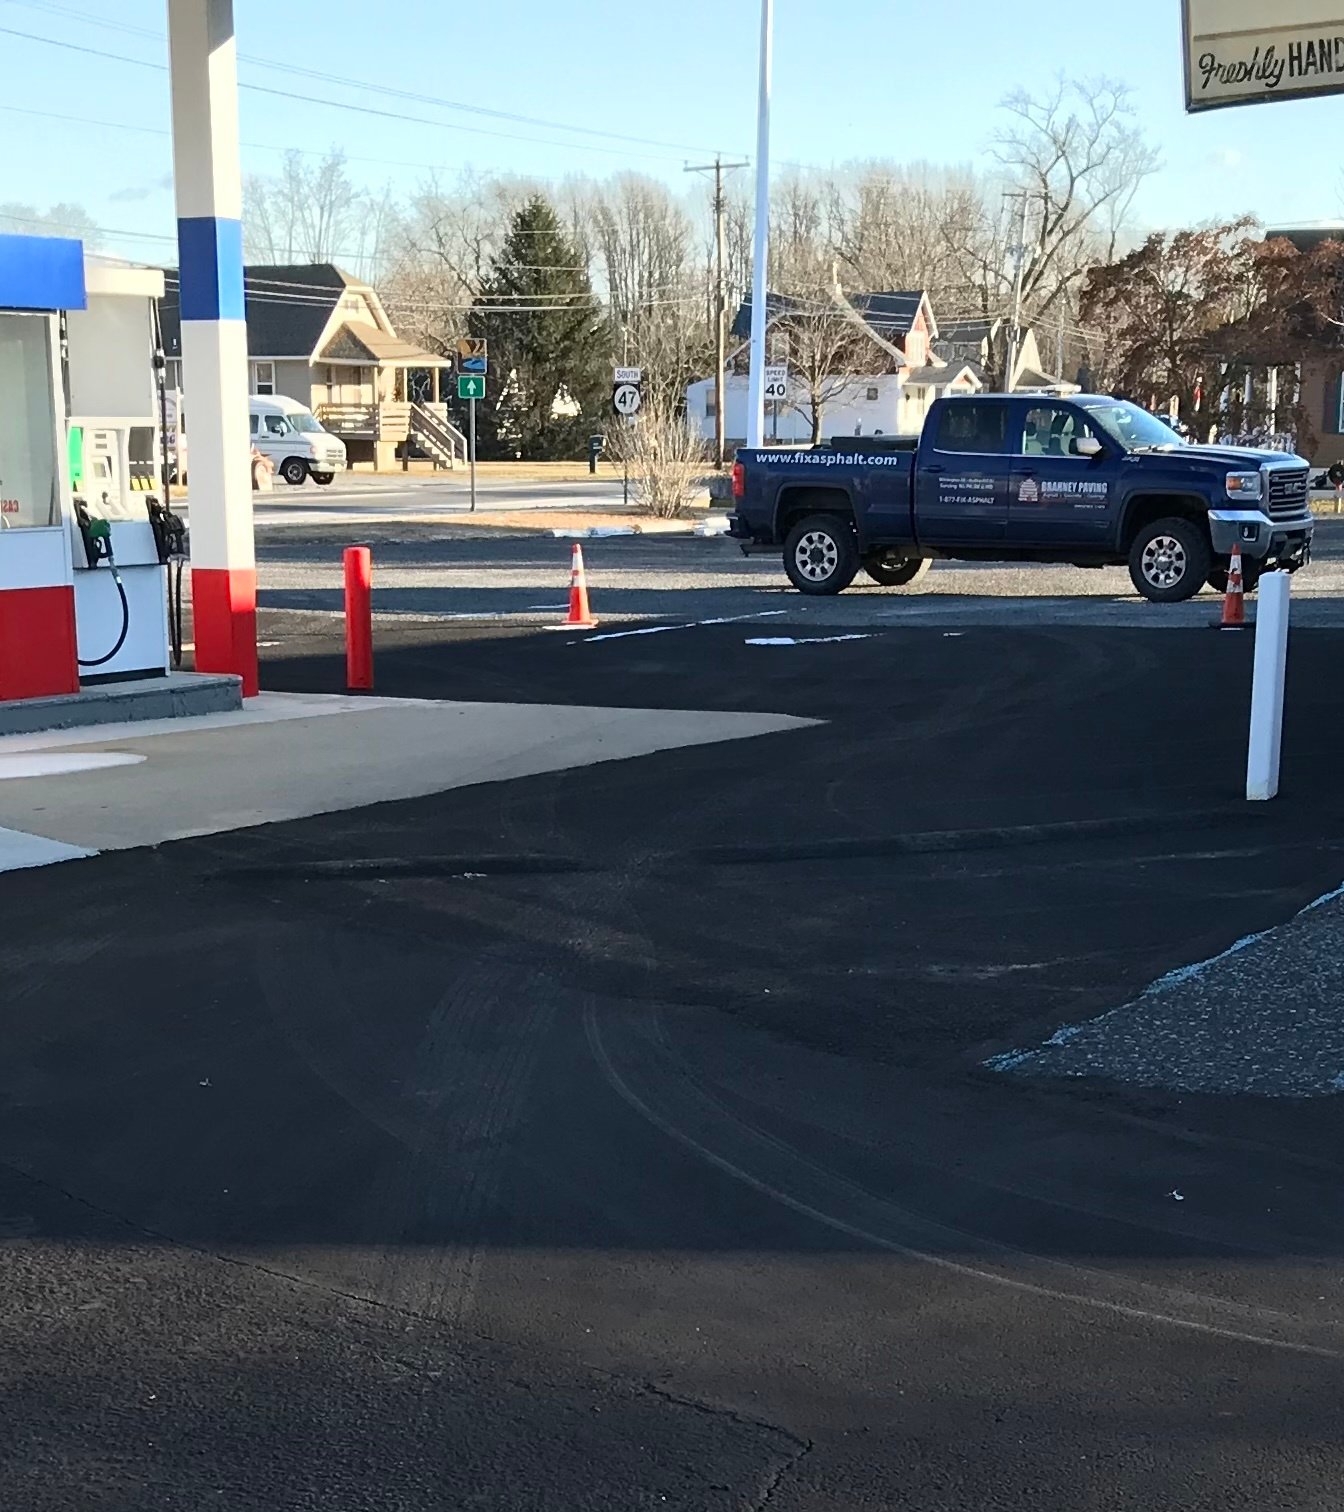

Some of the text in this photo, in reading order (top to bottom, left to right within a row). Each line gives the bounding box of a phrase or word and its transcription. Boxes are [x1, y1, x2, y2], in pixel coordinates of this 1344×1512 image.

[1198, 46, 1286, 90] Freshly
[616, 370, 639, 379] SOUTH
[766, 383, 786, 396] 40
[618, 391, 637, 408] 47
[756, 452, 898, 467] www.fixasphalt.com
[1078, 482, 1108, 494] PAVING
